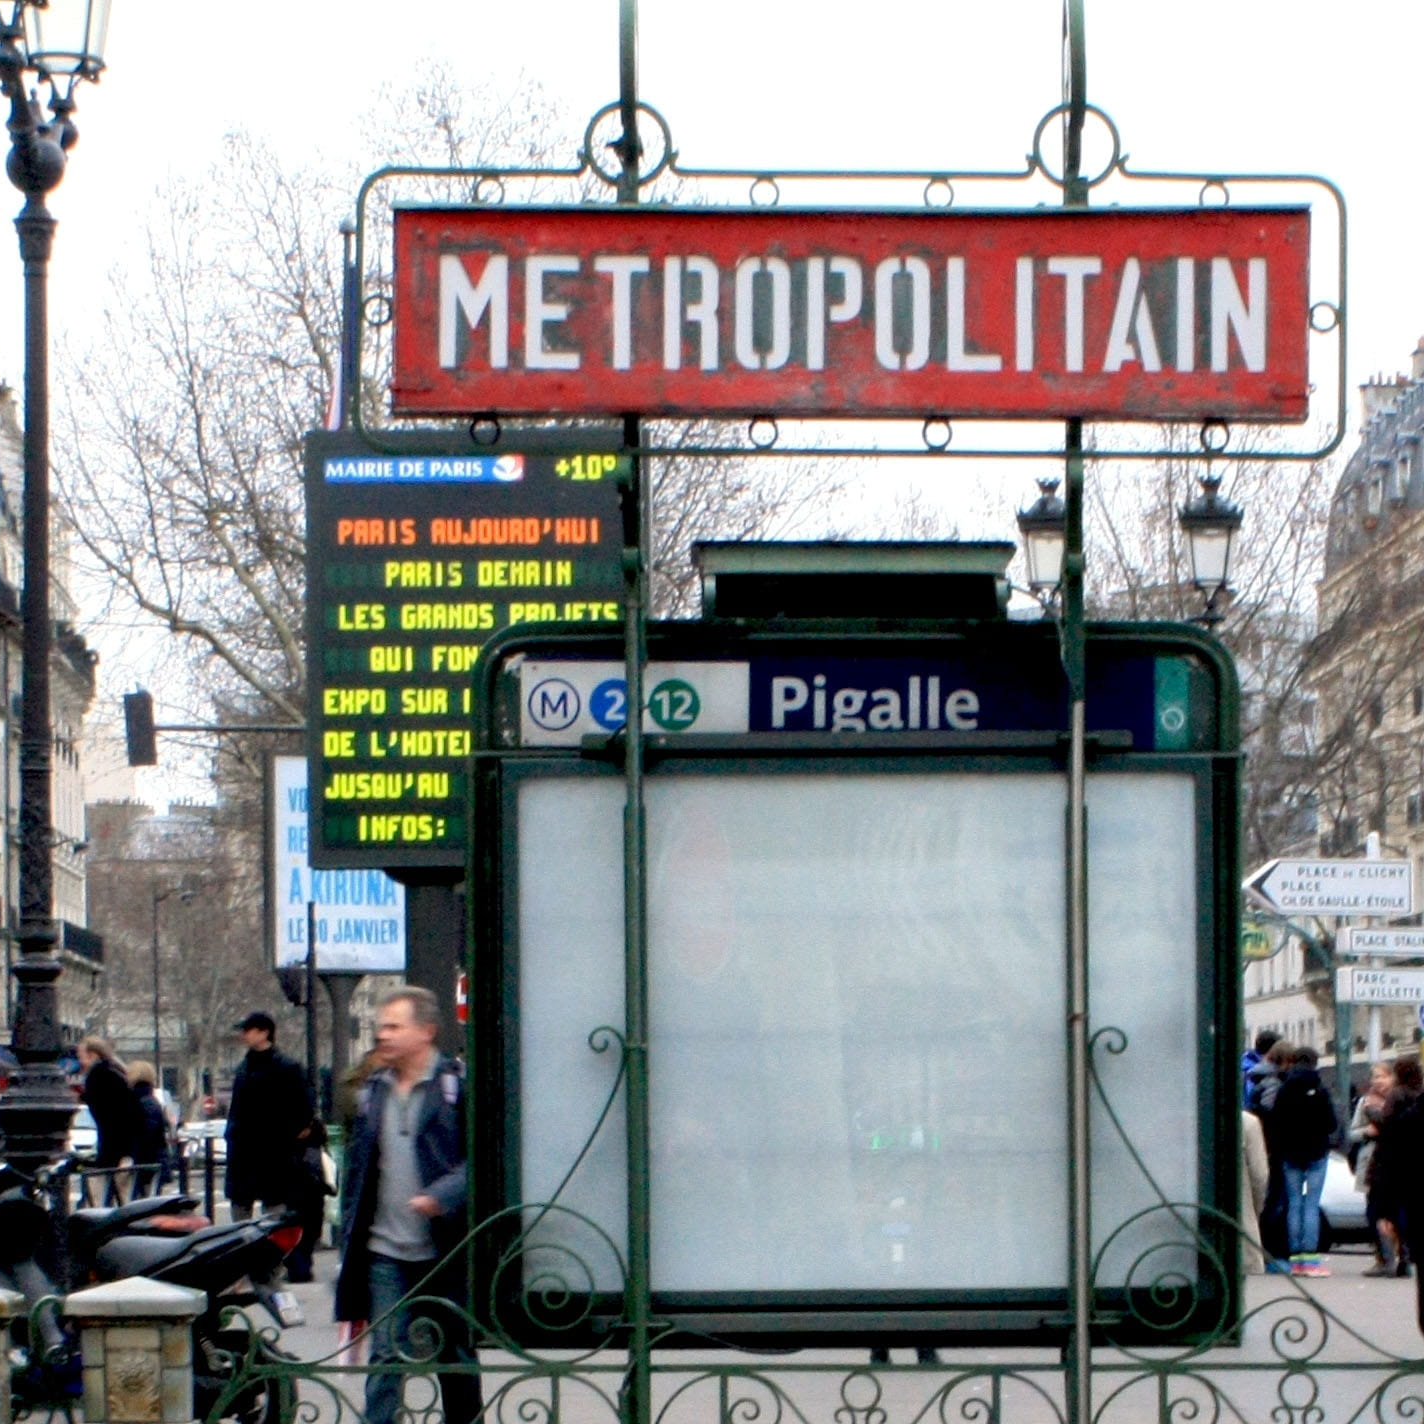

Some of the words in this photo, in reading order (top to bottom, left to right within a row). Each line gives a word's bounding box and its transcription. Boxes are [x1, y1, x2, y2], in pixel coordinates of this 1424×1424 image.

[437, 255, 1269, 372] METROPOLITAIN
[326, 461, 392, 478] MAIRIE
[399, 461, 425, 478] DE
[431, 460, 482, 477] PARIS
[337, 518, 416, 545] PARIS
[431, 518, 599, 545] AUJOURD'HUI
[385, 561, 463, 588] PARIS
[478, 561, 573, 587] DEMAIN
[338, 604, 386, 630] LES
[401, 604, 494, 630] GRANDS
[509, 602, 618, 624] PROJETS
[370, 646, 413, 672] QUI
[324, 688, 387, 715] EXPO
[401, 688, 448, 714] SUR
[771, 673, 980, 733] Pigalle
[324, 731, 356, 757] DE
[370, 730, 471, 757] L'HOTE
[325, 773, 449, 799] JUSQU'AU
[359, 815, 445, 841] INFOS:
[1297, 866, 1336, 878] PLACE
[1358, 867, 1406, 878] CLICHY
[311, 869, 397, 906] KIRUNA
[1281, 881, 1320, 892] PLACE
[287, 919, 305, 944] LE
[334, 919, 399, 944] JANVIER
[1354, 935, 1387, 947] PLACE
[1356, 973, 1385, 985] PARC
[1369, 986, 1421, 998] VILLETTE
